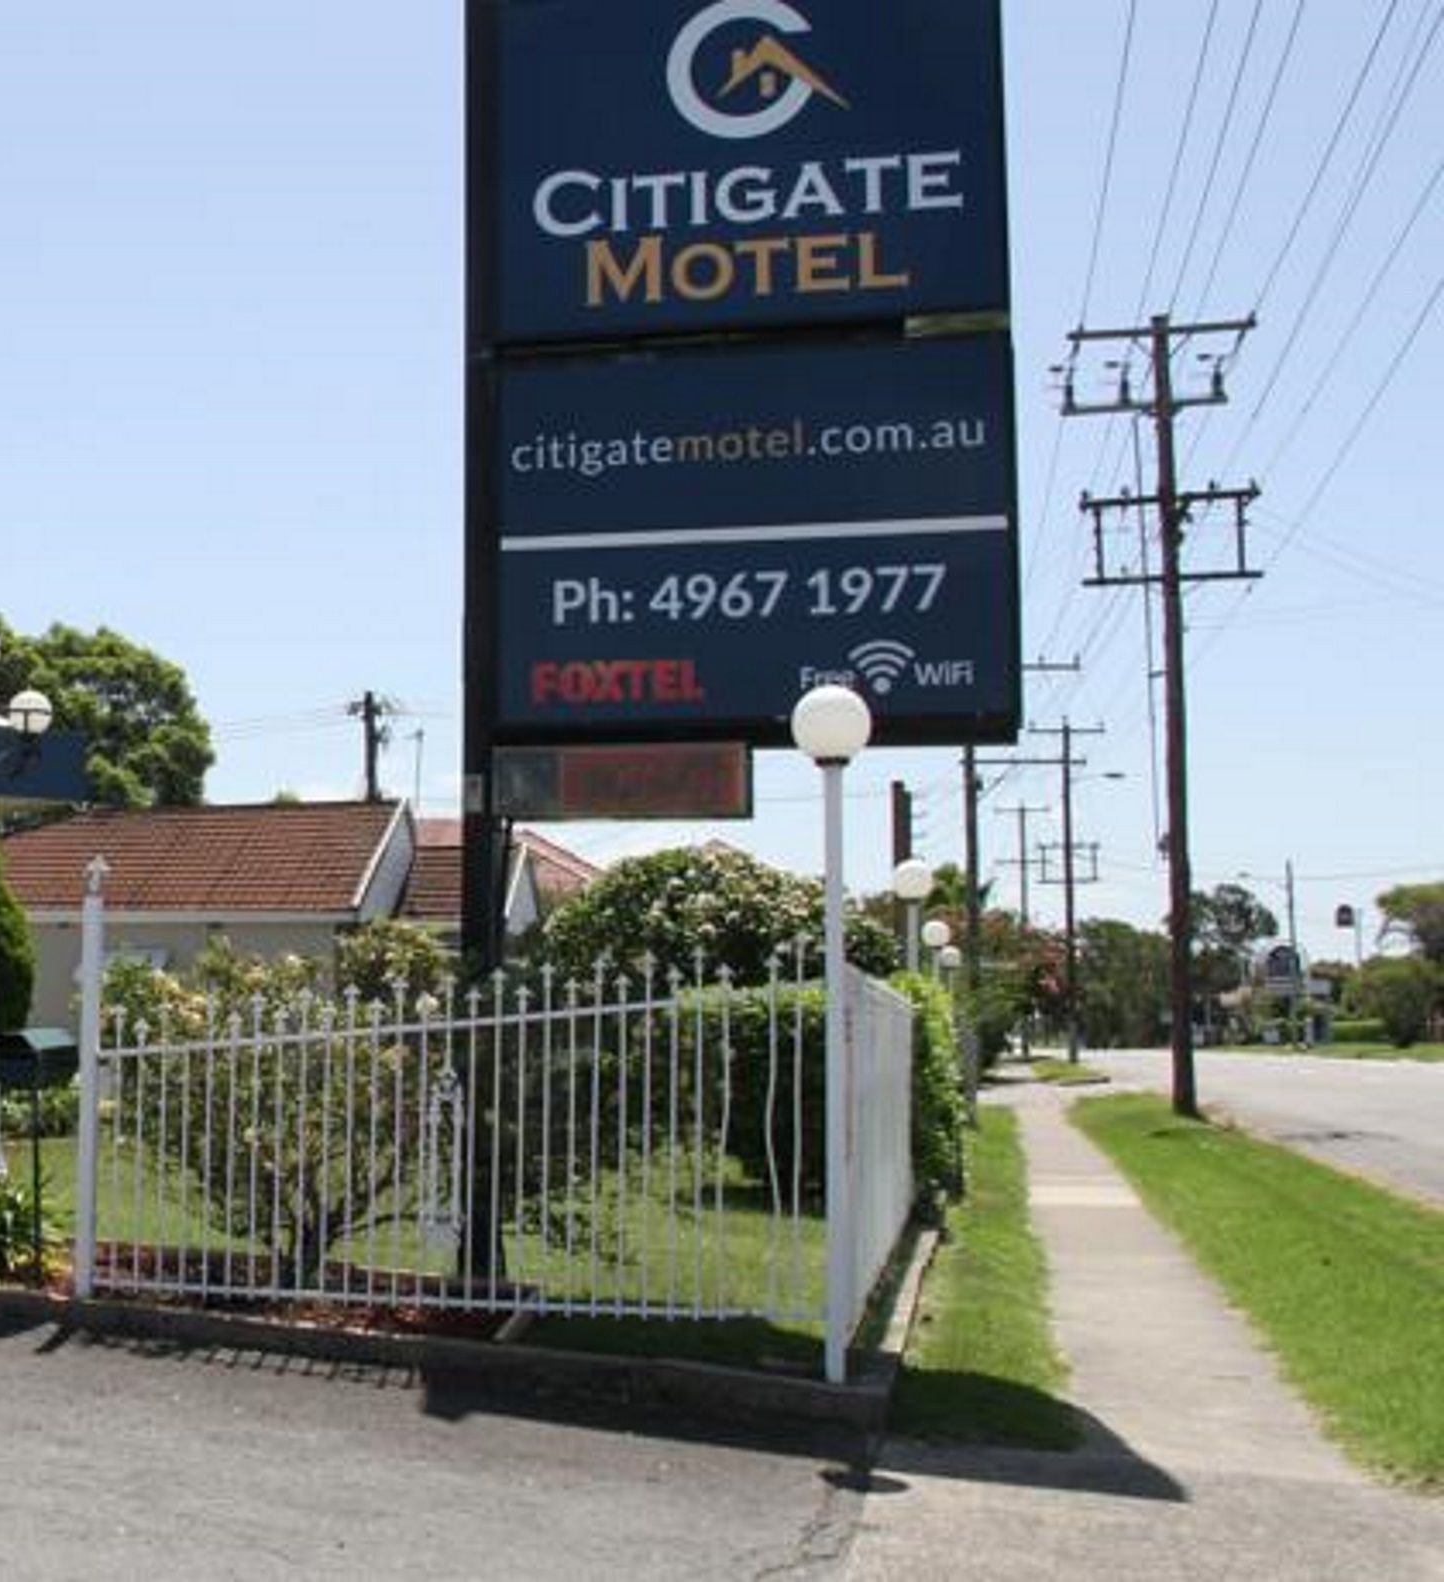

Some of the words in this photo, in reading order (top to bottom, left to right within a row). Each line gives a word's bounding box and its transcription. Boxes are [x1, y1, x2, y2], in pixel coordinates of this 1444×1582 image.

[532, 150, 964, 237] CITIGATE
[586, 231, 910, 308] MOTEL
[511, 418, 987, 475] citigatemotel.com.au
[553, 578, 635, 625] Ph:
[649, 570, 789, 620] 4967
[806, 563, 947, 615] 1977
[531, 660, 703, 704] FOXTEL
